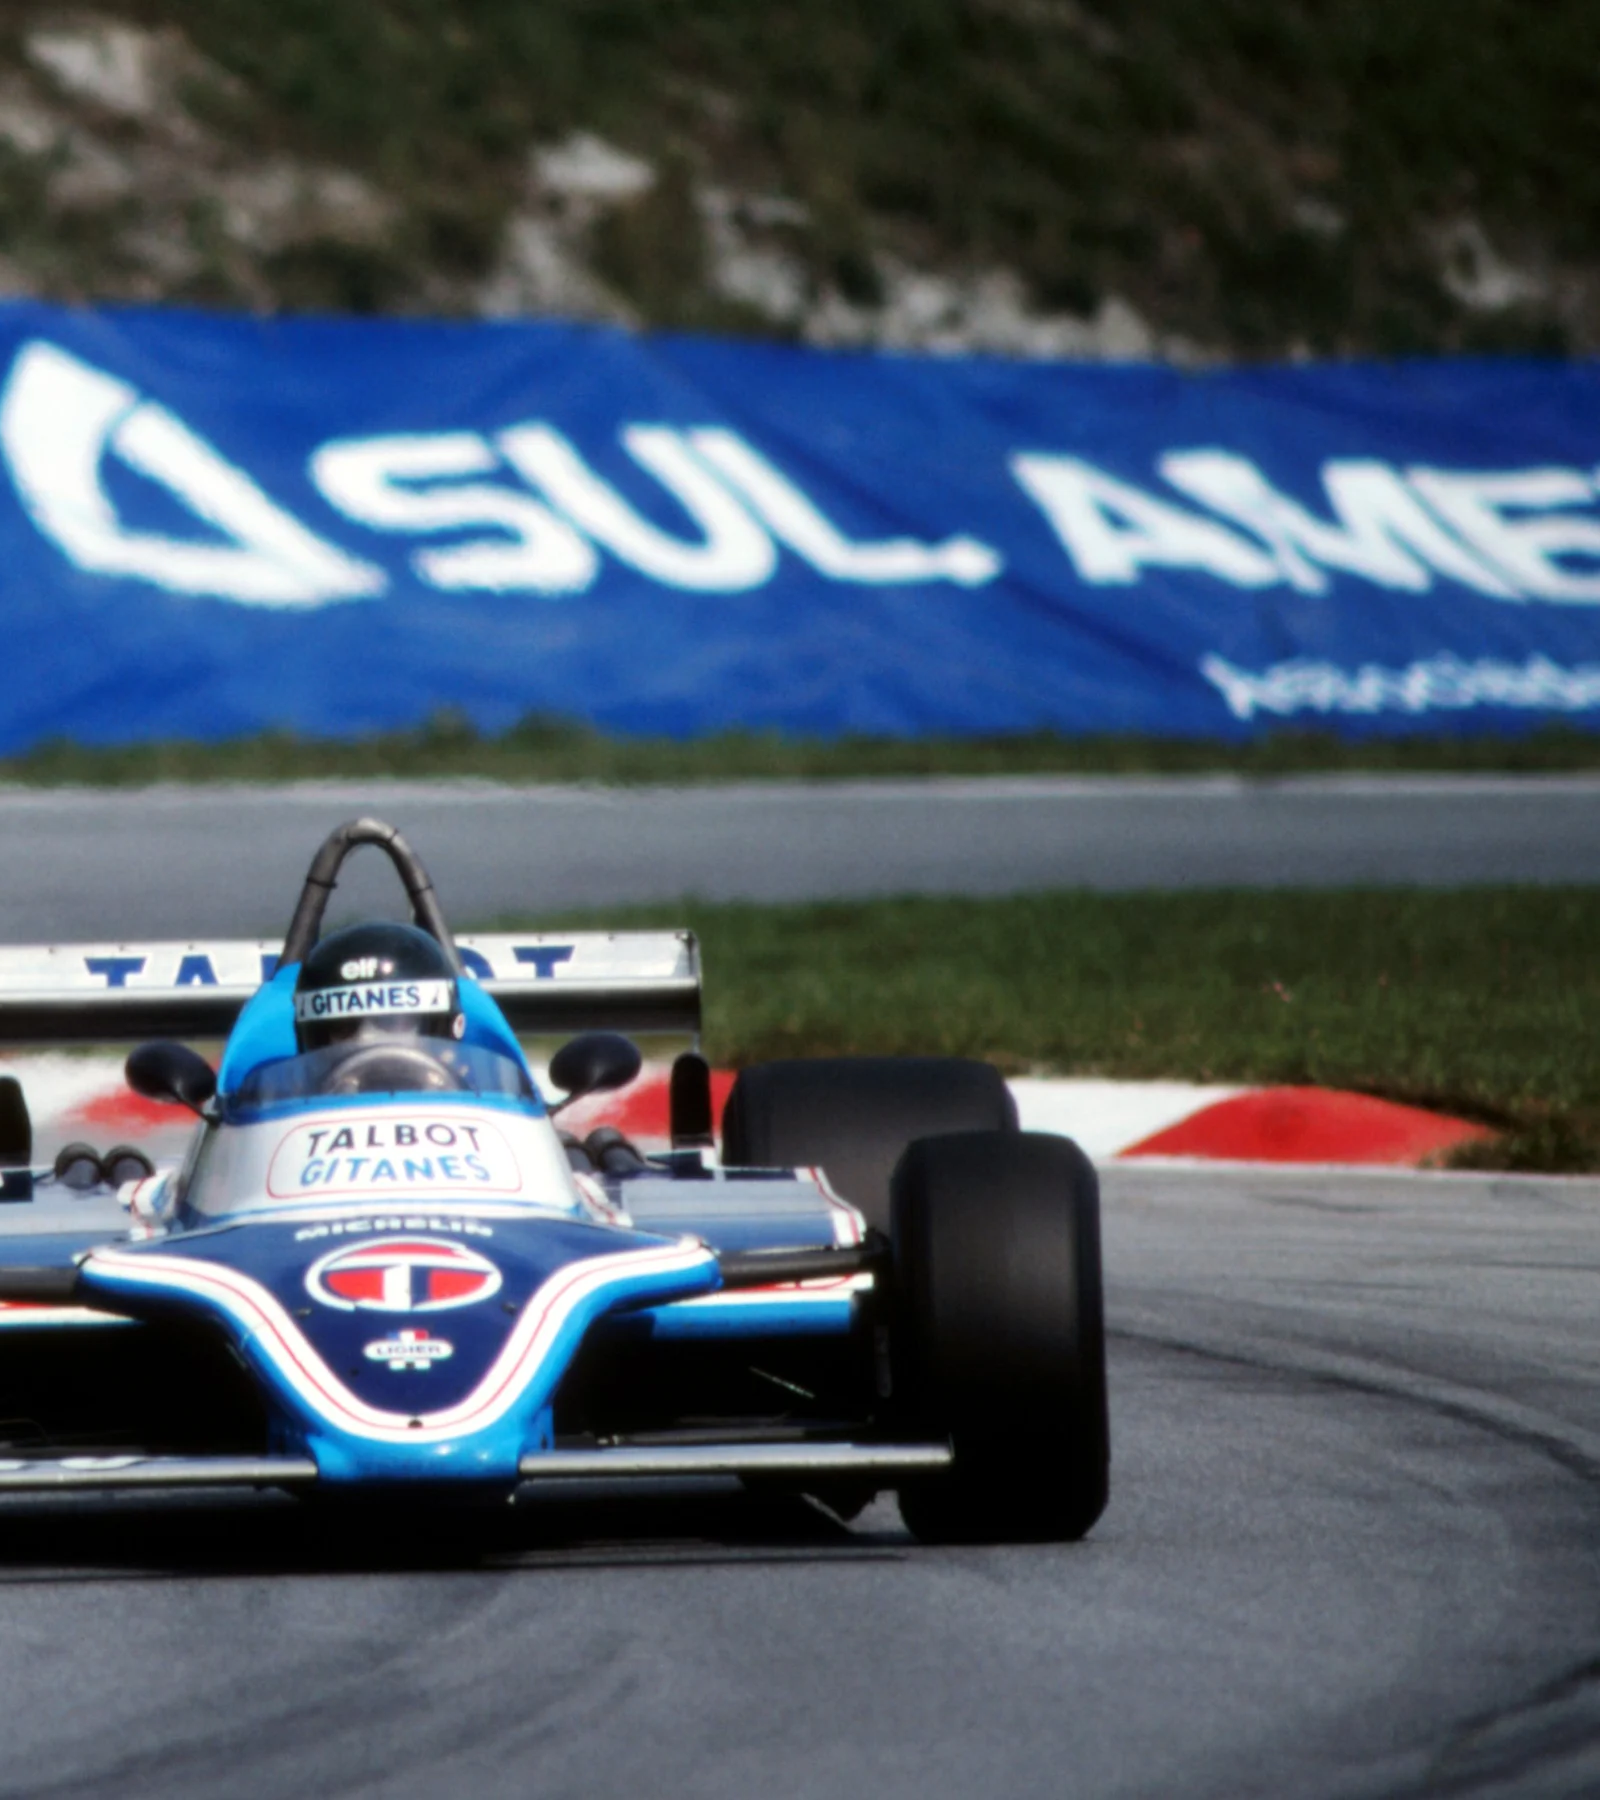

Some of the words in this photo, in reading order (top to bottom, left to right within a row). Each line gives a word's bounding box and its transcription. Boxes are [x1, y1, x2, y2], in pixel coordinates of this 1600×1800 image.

[1006, 447, 1600, 606] AME
[340, 957, 378, 981] elf
[312, 985, 421, 1016] GITANES
[307, 1123, 481, 1158] TALBOT
[299, 1153, 491, 1188] GITANES
[295, 1216, 494, 1242] MICHELIN
[375, 1343, 443, 1356] LIGIER
